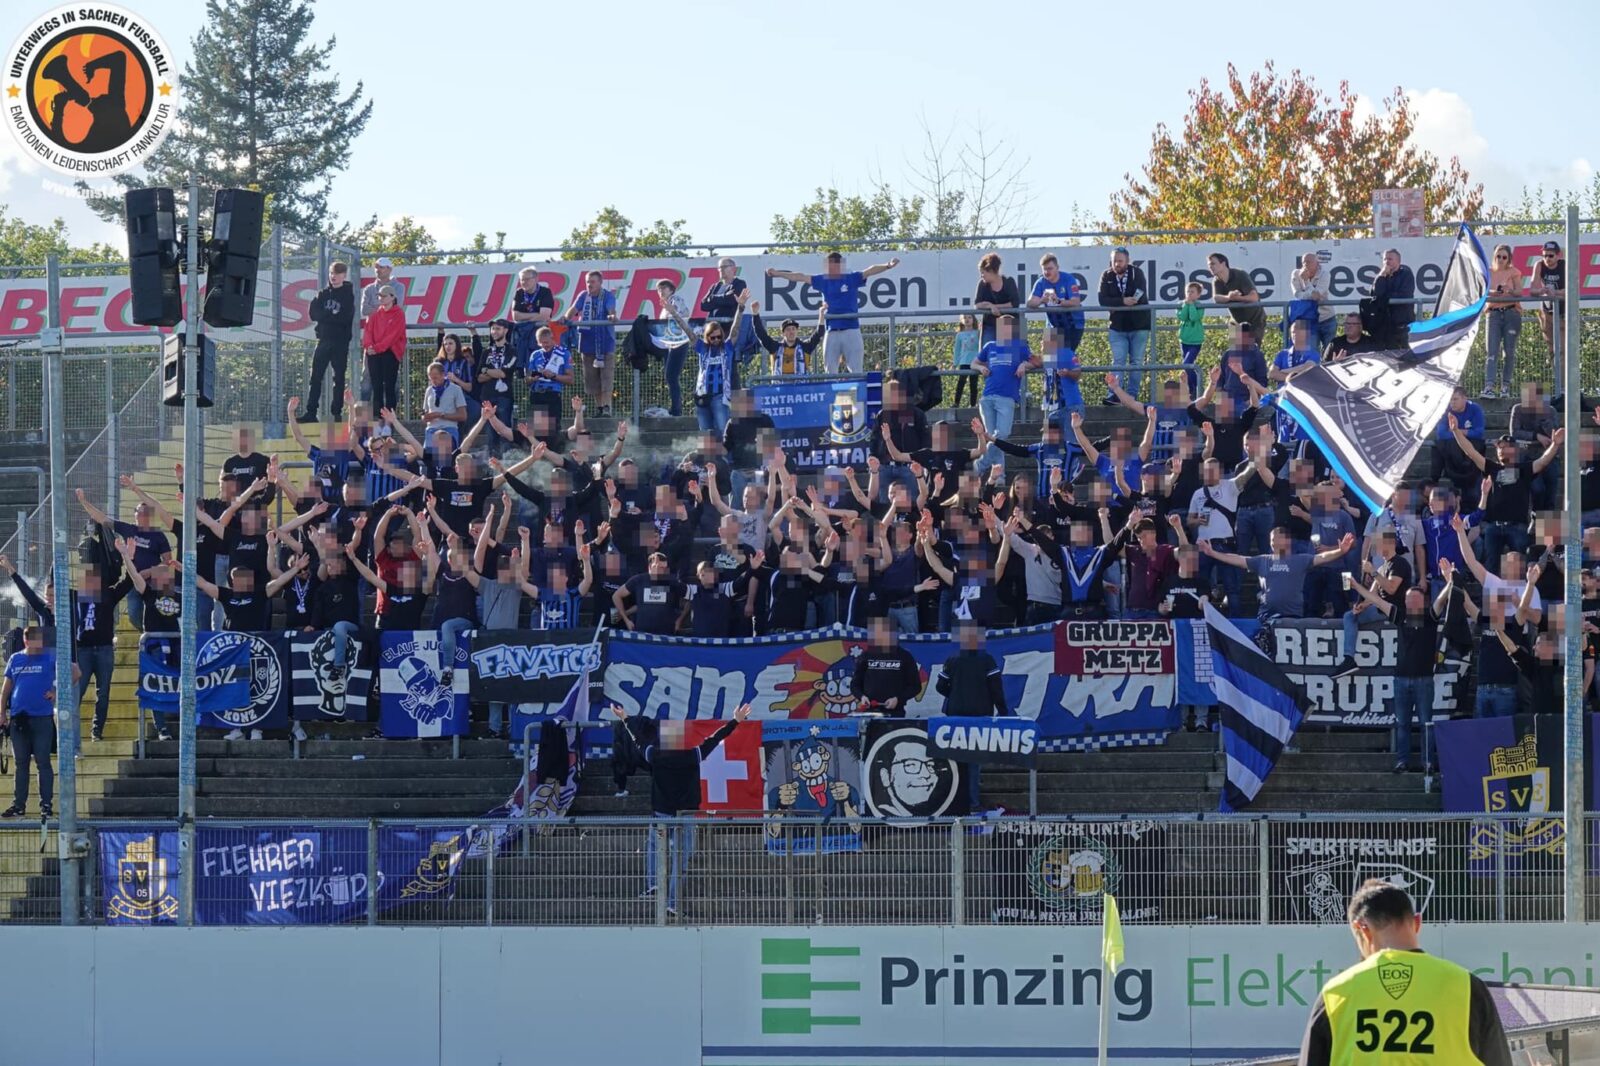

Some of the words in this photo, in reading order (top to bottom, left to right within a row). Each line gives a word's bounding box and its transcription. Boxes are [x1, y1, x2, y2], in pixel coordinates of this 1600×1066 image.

[1067, 621, 1173, 647] GRUPPA
[382, 641, 420, 663] BLAUE
[1084, 648, 1163, 674] METZ
[1285, 672, 1459, 713] RUPE
[223, 709, 258, 723] KONZ
[934, 724, 1037, 755] CANNIS
[202, 838, 315, 877] FIEHRER
[1286, 837, 1438, 857] SPORTFREUNDE
[1382, 969, 1411, 980] EOS
[881, 955, 1153, 1022] Prinzing
[1355, 1008, 1435, 1055] 522
